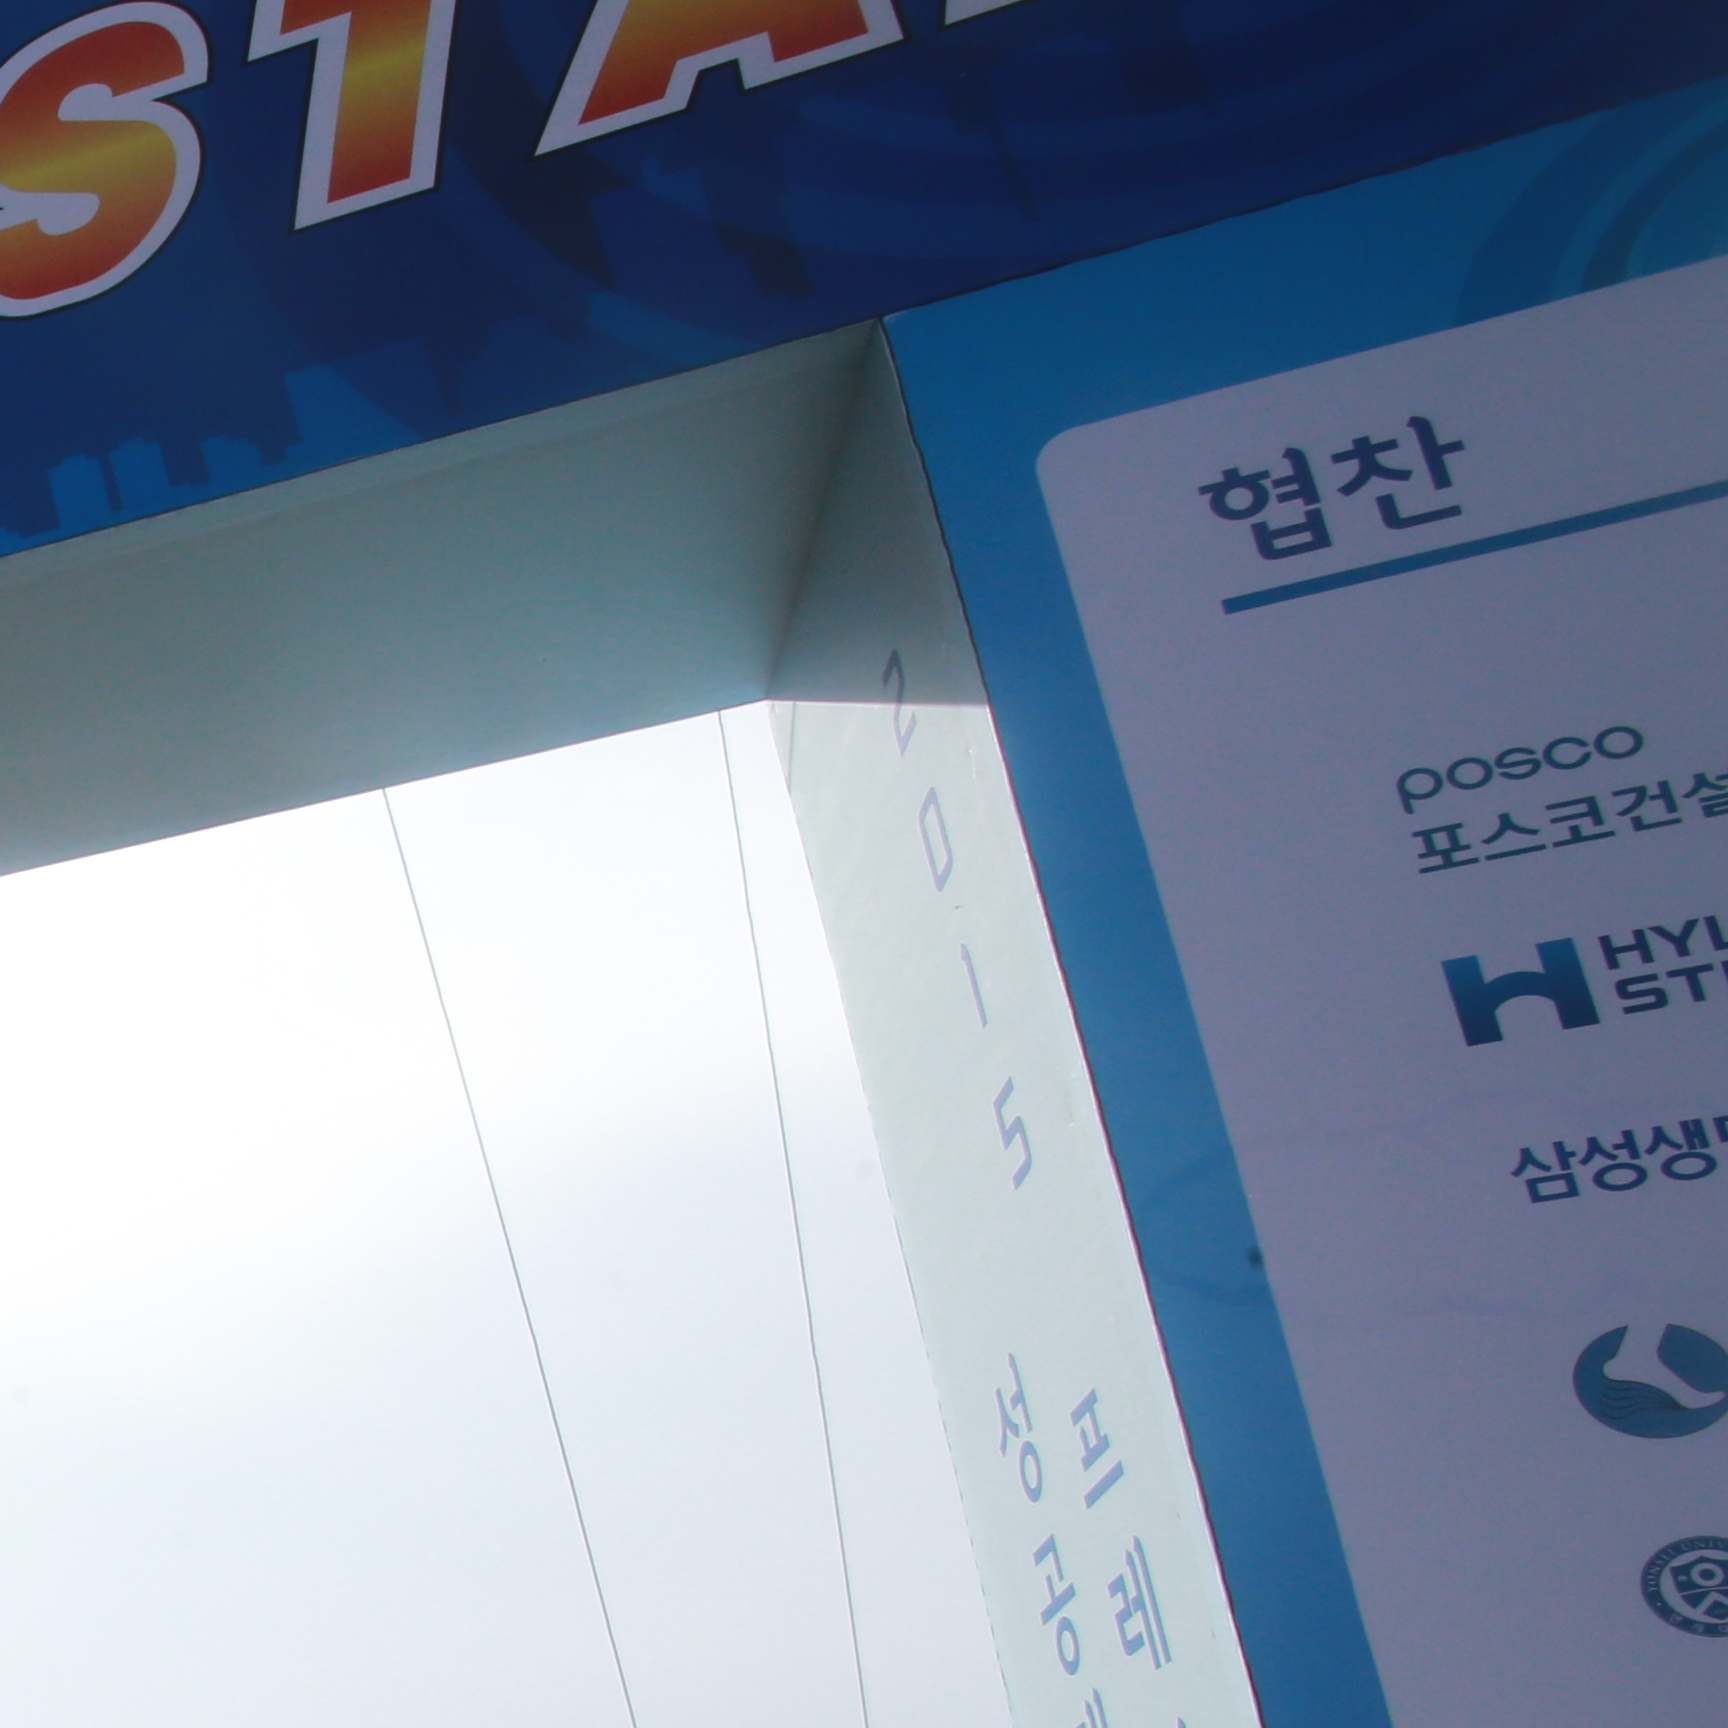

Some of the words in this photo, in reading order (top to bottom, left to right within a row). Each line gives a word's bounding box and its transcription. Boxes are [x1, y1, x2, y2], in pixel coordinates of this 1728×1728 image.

[1198, 415, 1465, 560] 협찬
[1397, 726, 1644, 814] posco
[882, 648, 1032, 1191] 2015
[1614, 963, 1728, 1015] ST
[1511, 1115, 1728, 1203] 삼성생
